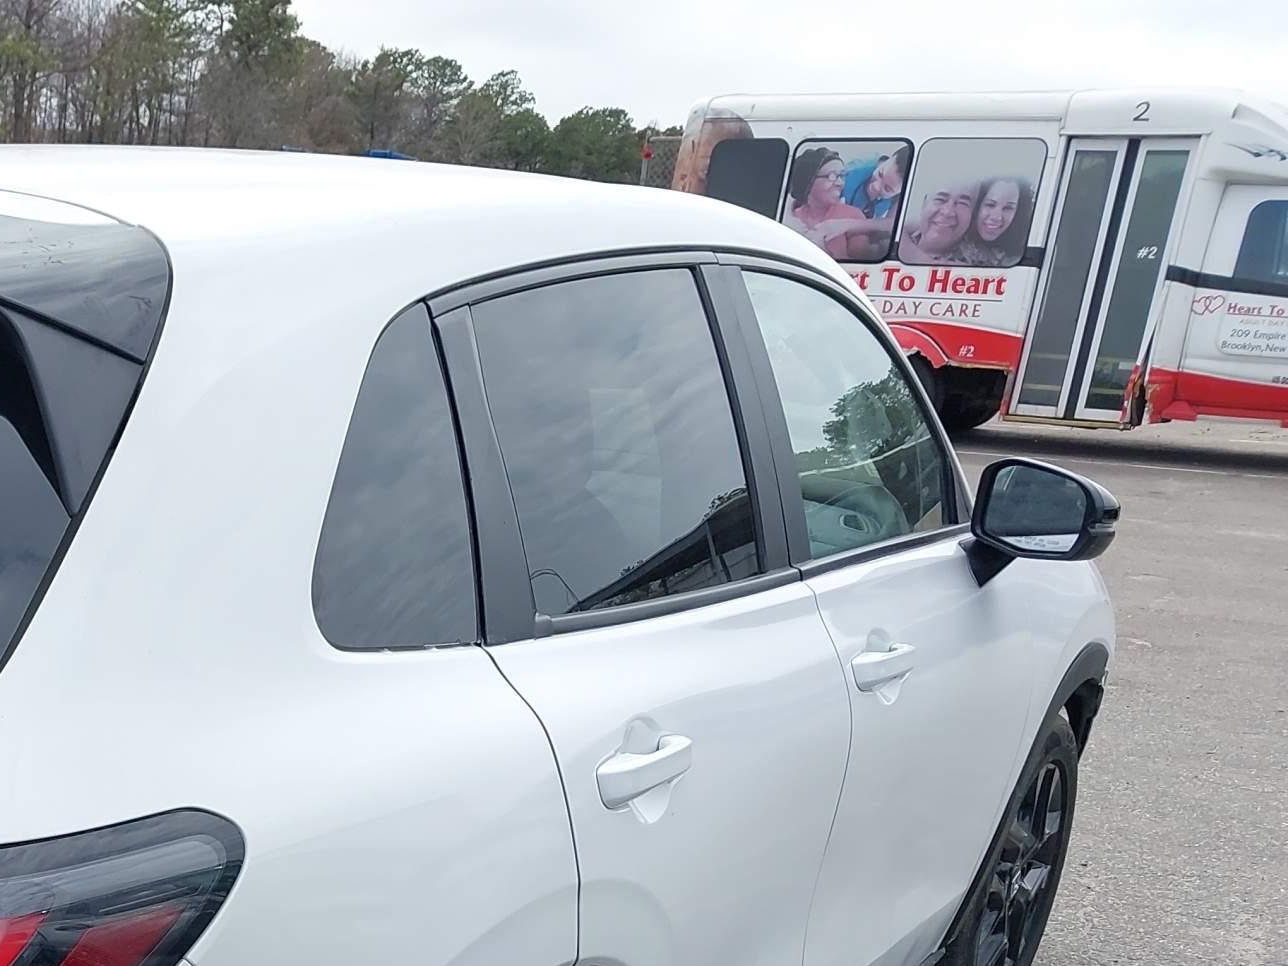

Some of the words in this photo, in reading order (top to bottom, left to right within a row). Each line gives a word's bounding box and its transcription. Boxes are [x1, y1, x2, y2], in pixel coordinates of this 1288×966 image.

[1132, 100, 1151, 122] 2
[1137, 246, 1158, 260] #2
[881, 268, 916, 292] To
[927, 269, 1008, 296] Heart
[881, 300, 923, 316] DAY
[929, 302, 983, 318] CARE
[1226, 302, 1263, 315] Heart
[1269, 304, 1286, 316] To
[1230, 328, 1251, 338] 209
[1253, 329, 1286, 341] Empire
[958, 344, 975, 358] #2
